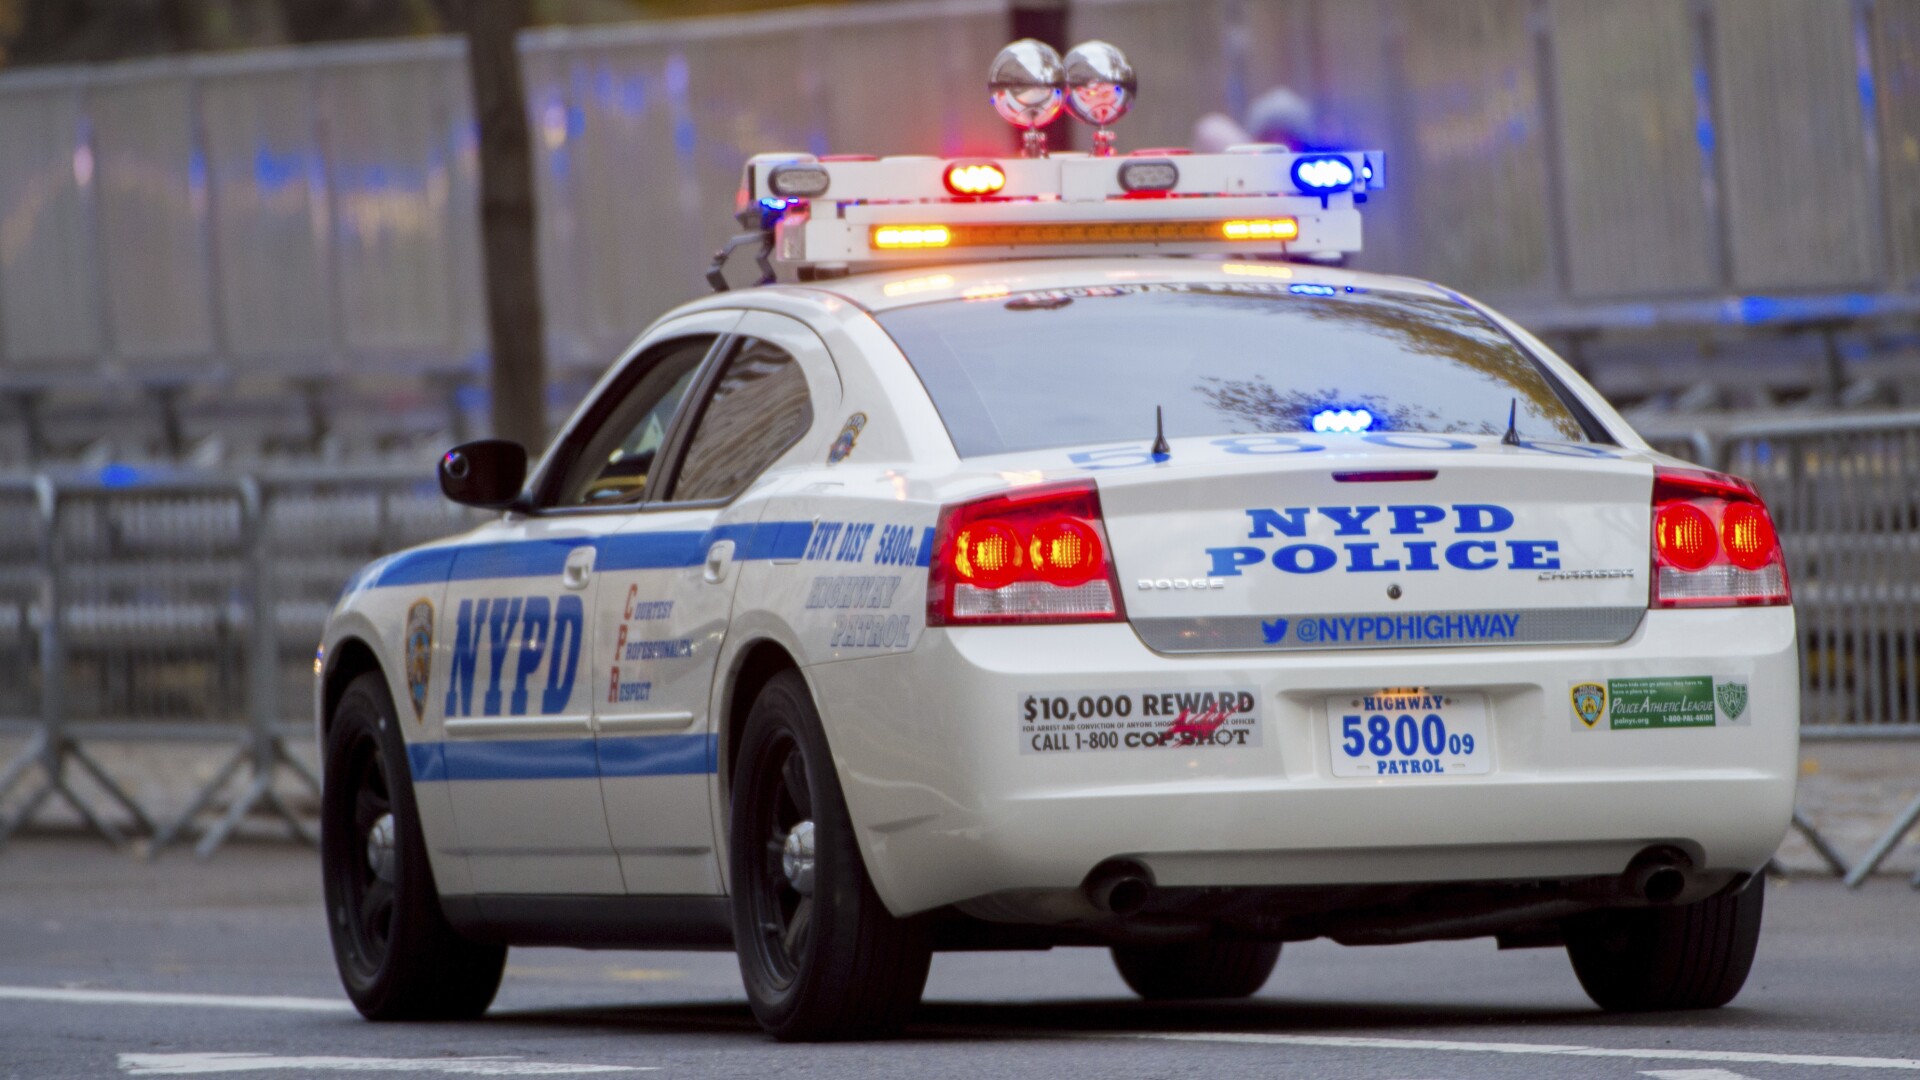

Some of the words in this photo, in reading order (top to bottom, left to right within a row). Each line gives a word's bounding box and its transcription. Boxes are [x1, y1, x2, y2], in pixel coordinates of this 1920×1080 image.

[1246, 504, 1514, 539] NYPD
[806, 522, 844, 561] HWY
[836, 522, 875, 562] DIST
[1205, 540, 1561, 577] POLICE
[1138, 578, 1224, 590] DODGE
[1538, 568, 1634, 581] CHARGER
[805, 576, 902, 609] HIGHWAY
[830, 614, 911, 648] PATROL
[1296, 613, 1520, 643] @NYPDHIGHWAY
[444, 595, 584, 717] NYPD
[608, 666, 652, 703] RESPECT
[1024, 695, 1133, 723] $10,000
[1142, 691, 1255, 716] REWARD
[1363, 695, 1443, 711] HIGHWAY
[1077, 722, 1115, 730] CONVICTION
[1614, 717, 1649, 726] palnyc.org
[1662, 714, 1713, 723] 1-800-PAL-4KIDS
[1031, 733, 1070, 752] CALL
[1075, 731, 1119, 750] 1-800
[1124, 729, 1250, 749] COP-SHOT
[1377, 759, 1444, 774] PATROL
